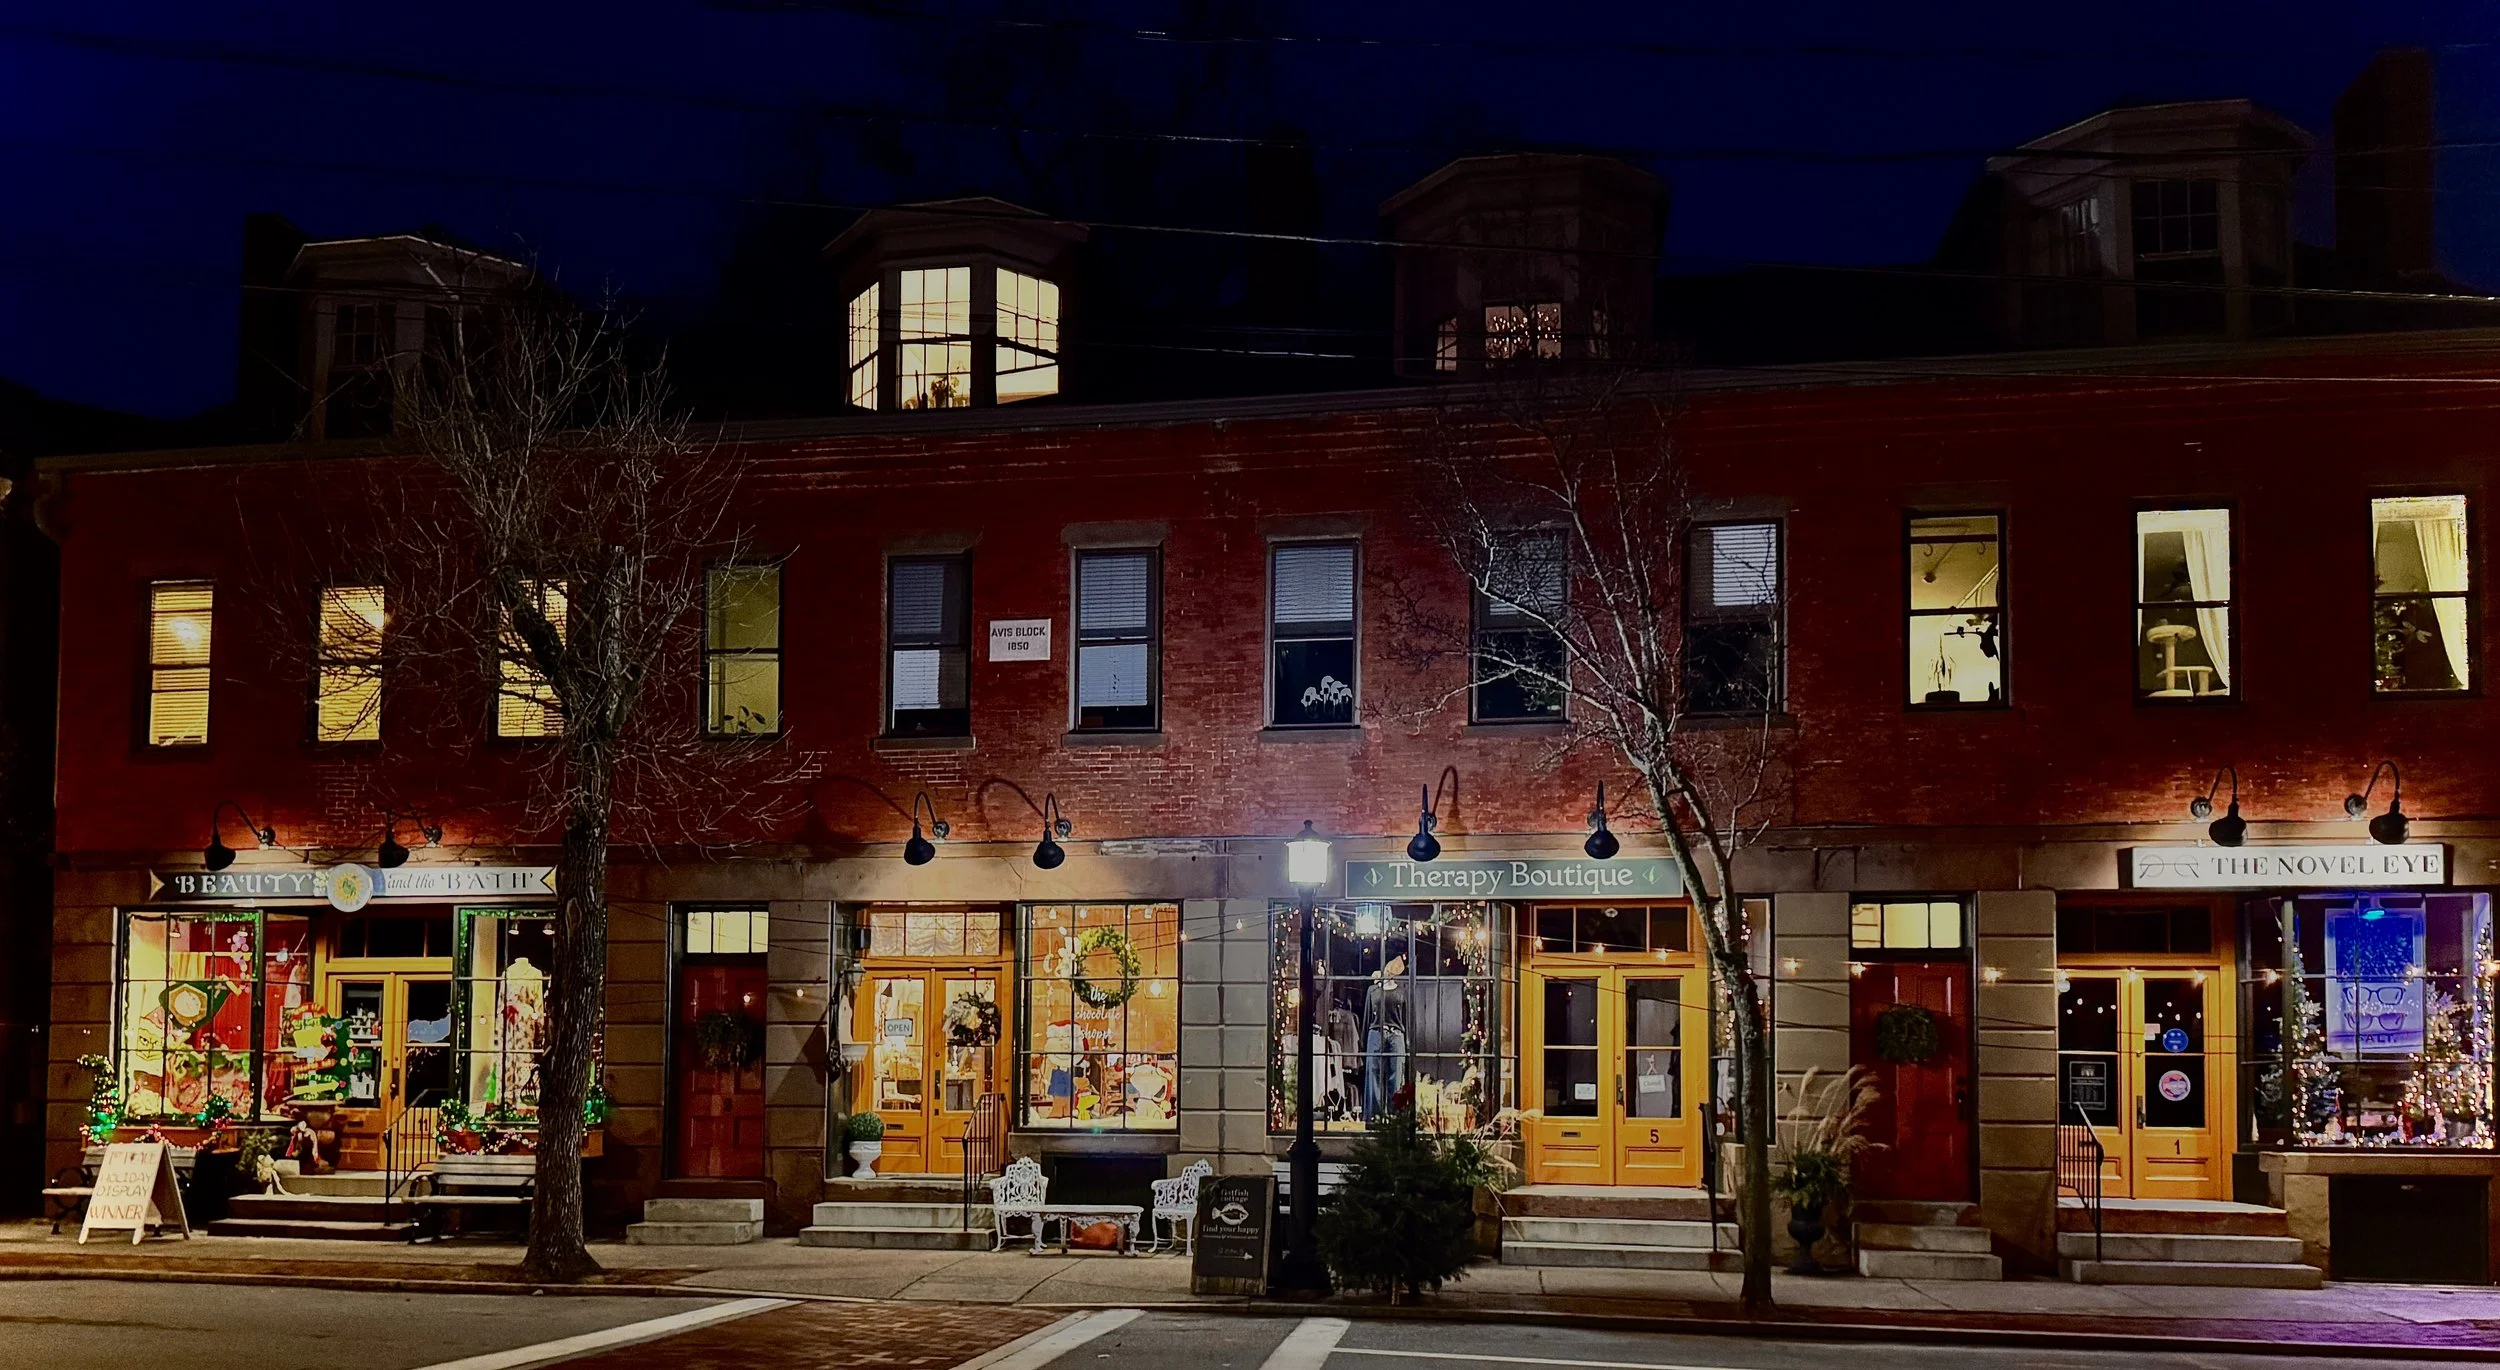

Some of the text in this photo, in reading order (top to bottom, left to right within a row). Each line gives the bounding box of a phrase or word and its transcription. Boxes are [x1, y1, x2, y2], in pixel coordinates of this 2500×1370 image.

[991, 626, 1046, 637] AVIS BLOCK
[1007, 641, 1029, 651] 1850
[2211, 854, 2439, 876] THE NOVEL EYE
[1388, 861, 1634, 895] Therapy Boutique
[1090, 985, 1109, 1002] the
[1076, 1003, 1121, 1020] chocolate
[887, 1024, 910, 1032] OPEN
[1650, 1129, 1659, 1144] 5
[2174, 1139, 2180, 1155] 1
[96, 1185, 150, 1197] DISPLAY
[90, 1204, 144, 1219] WINNER
[1203, 1224, 1218, 1233] find
[1237, 1225, 1260, 1235] happy
